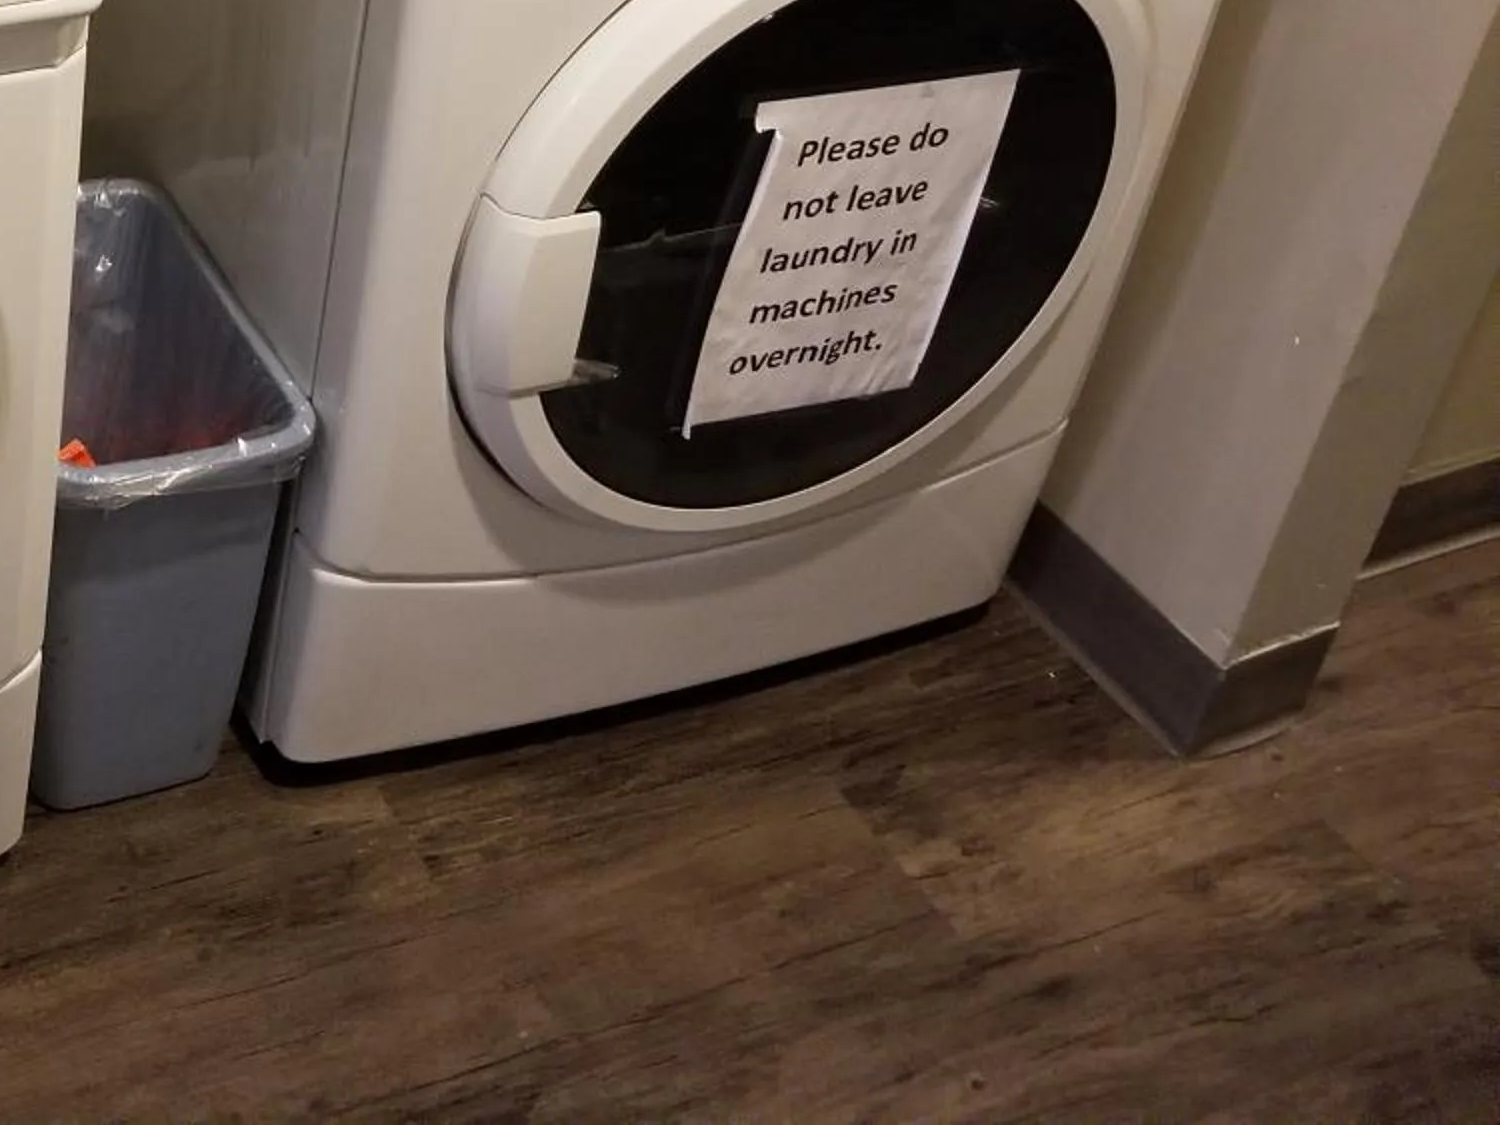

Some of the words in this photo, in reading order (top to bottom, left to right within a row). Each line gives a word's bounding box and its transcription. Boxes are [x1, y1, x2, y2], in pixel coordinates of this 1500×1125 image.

[798, 131, 900, 167] Please
[909, 122, 949, 152] do
[783, 191, 839, 221] not
[846, 180, 928, 213] leave
[760, 237, 883, 274] laundry
[890, 230, 918, 256] in
[749, 282, 898, 325] machines
[729, 329, 883, 376] overnight.
